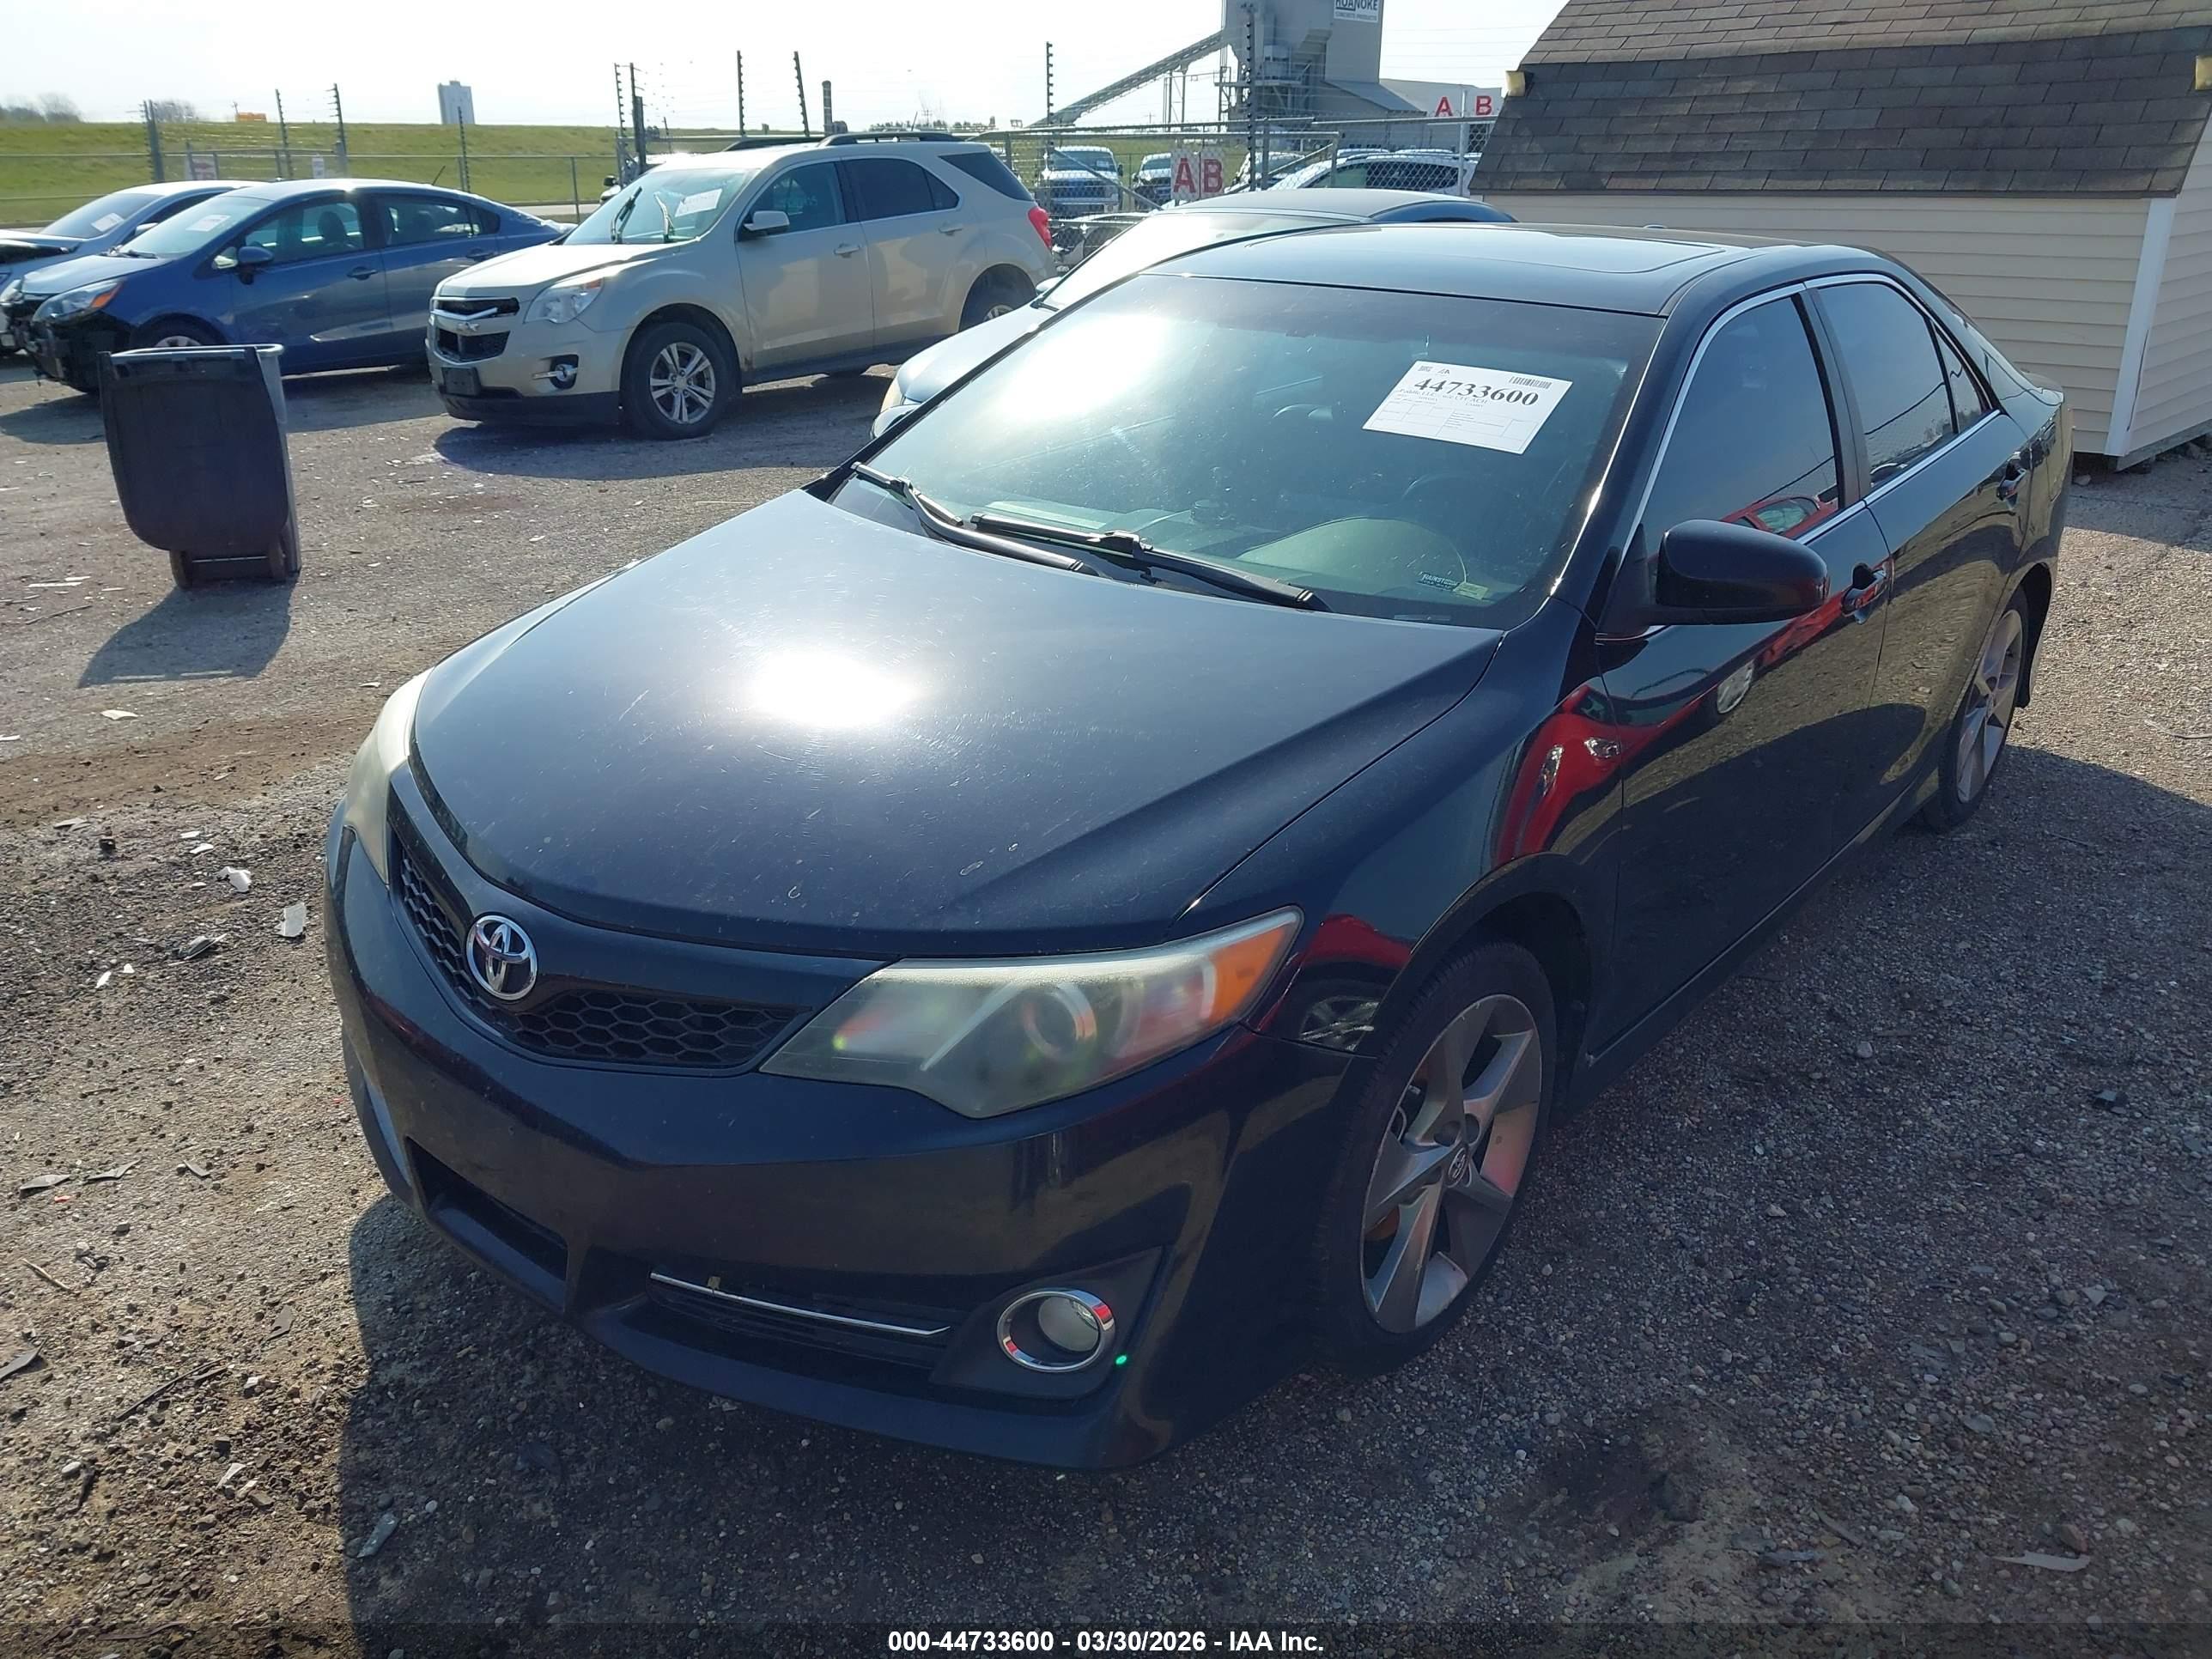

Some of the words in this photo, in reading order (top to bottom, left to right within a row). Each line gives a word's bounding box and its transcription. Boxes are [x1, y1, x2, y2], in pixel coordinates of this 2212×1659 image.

[1435, 96, 1453, 117] A
[1476, 95, 1492, 116] B
[1173, 158, 1196, 193] A
[1204, 159, 1223, 193] B
[1413, 378, 1539, 406] 44733600
